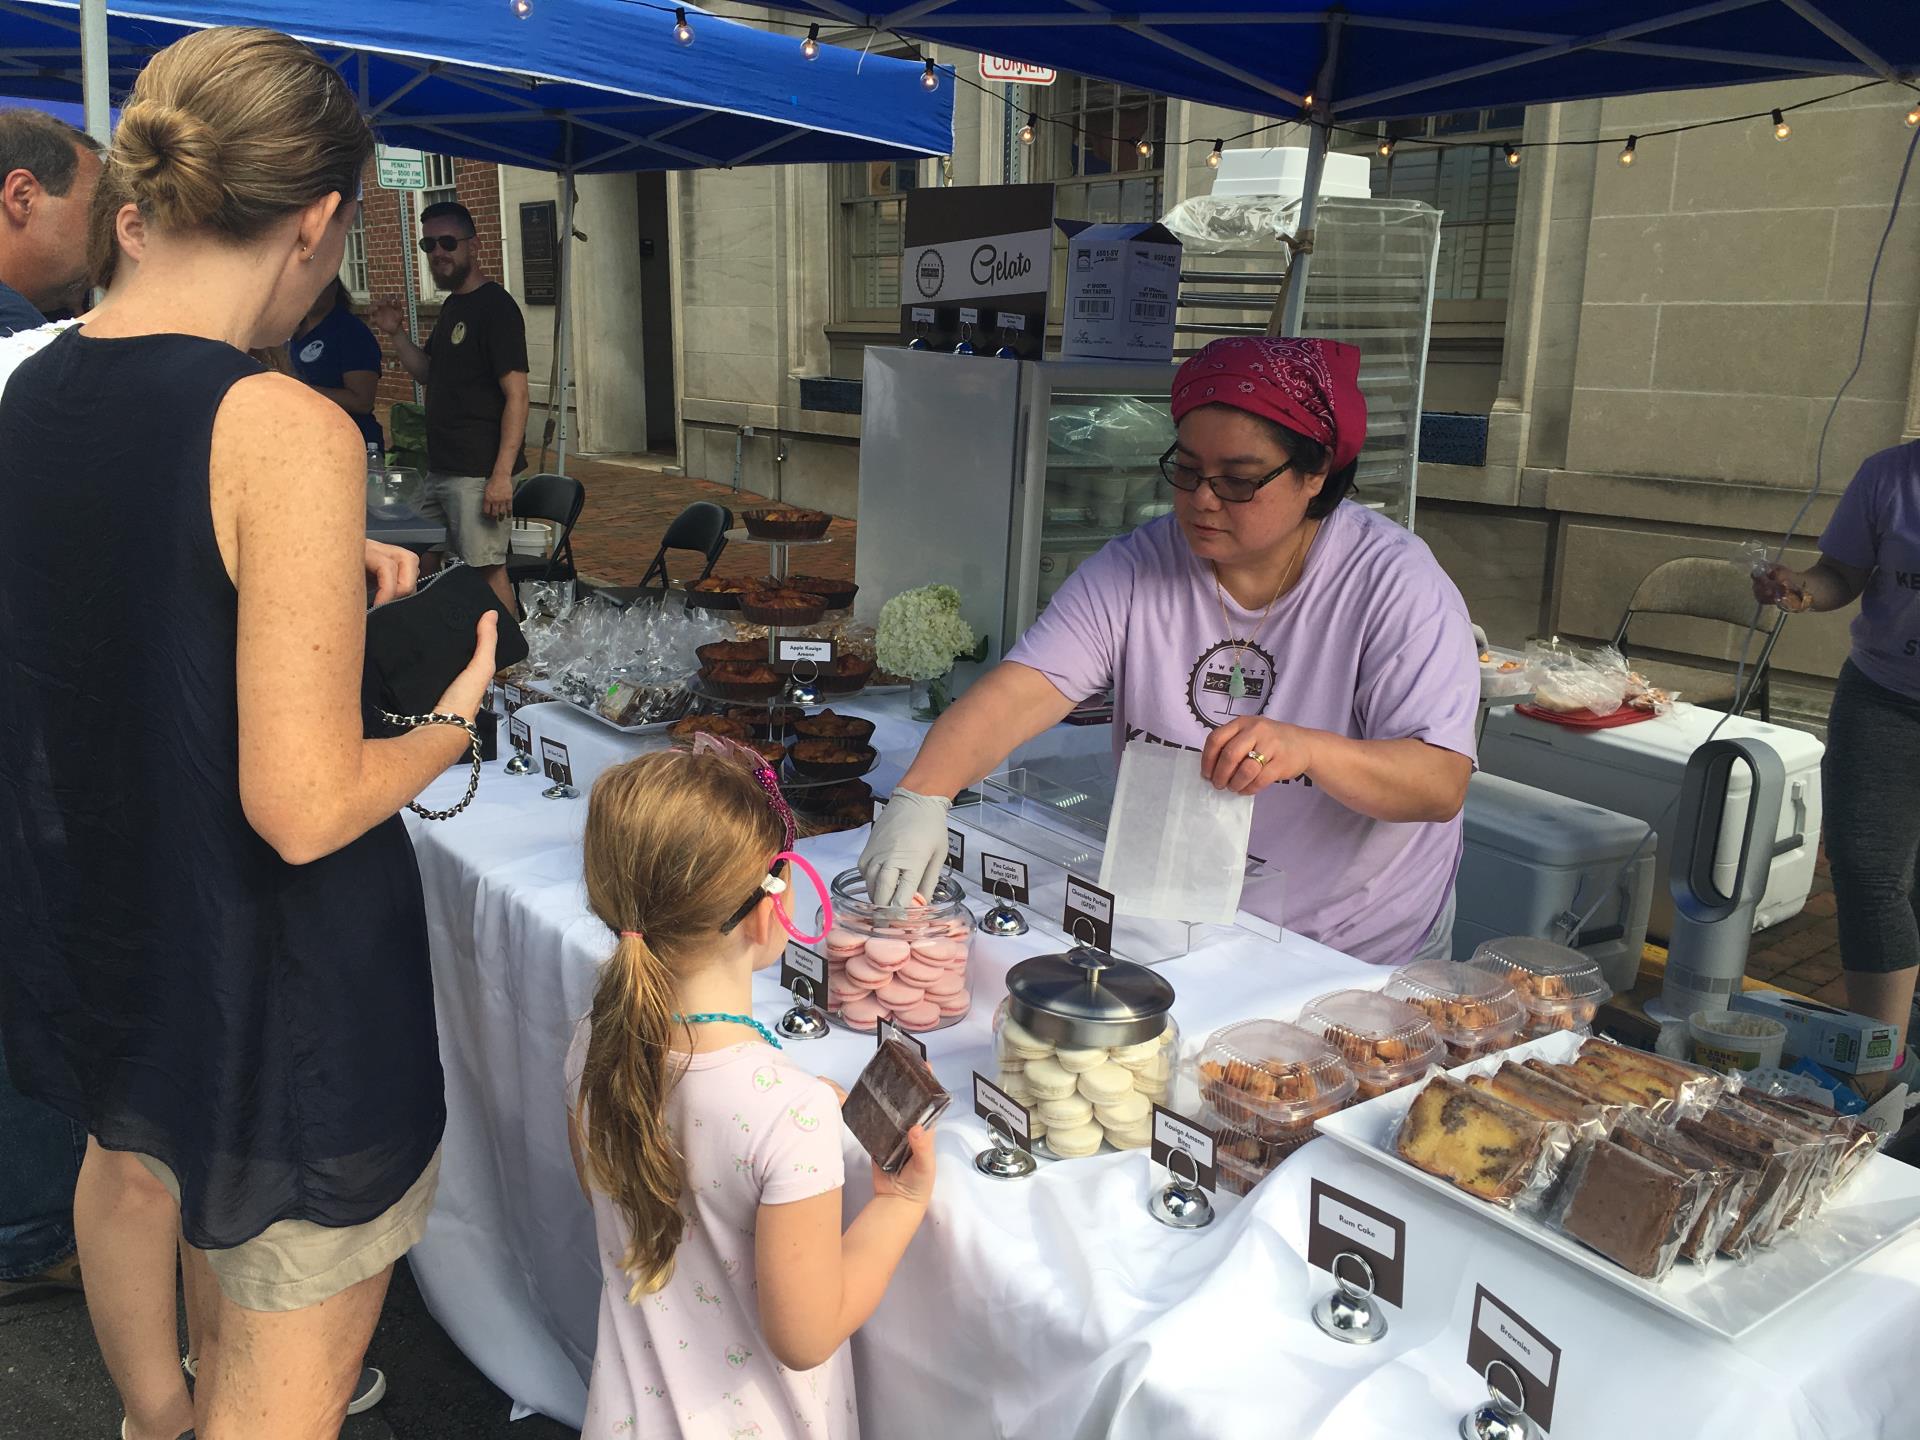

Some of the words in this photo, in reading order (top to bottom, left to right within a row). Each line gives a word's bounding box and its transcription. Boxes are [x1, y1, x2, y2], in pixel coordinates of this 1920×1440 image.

[390, 161, 412, 169] PENALTY
[970, 243, 1032, 287] Gelato
[990, 868, 1004, 877] Parfait
[1002, 864, 1016, 873] Colada
[1071, 887, 1092, 902] Chocolate
[1092, 896, 1108, 908] Parfait
[1081, 900, 1097, 912] (GFDF)
[981, 1089, 999, 1106] Vanilla
[999, 1103, 1023, 1125] Macarons
[1164, 1120, 1184, 1136] Kouign
[1185, 1131, 1205, 1147] Amann
[1177, 1136, 1191, 1149] Bites
[1339, 1213, 1356, 1228] Rum
[1357, 1223, 1376, 1238] Cake
[1500, 1323, 1531, 1356] Brownies
